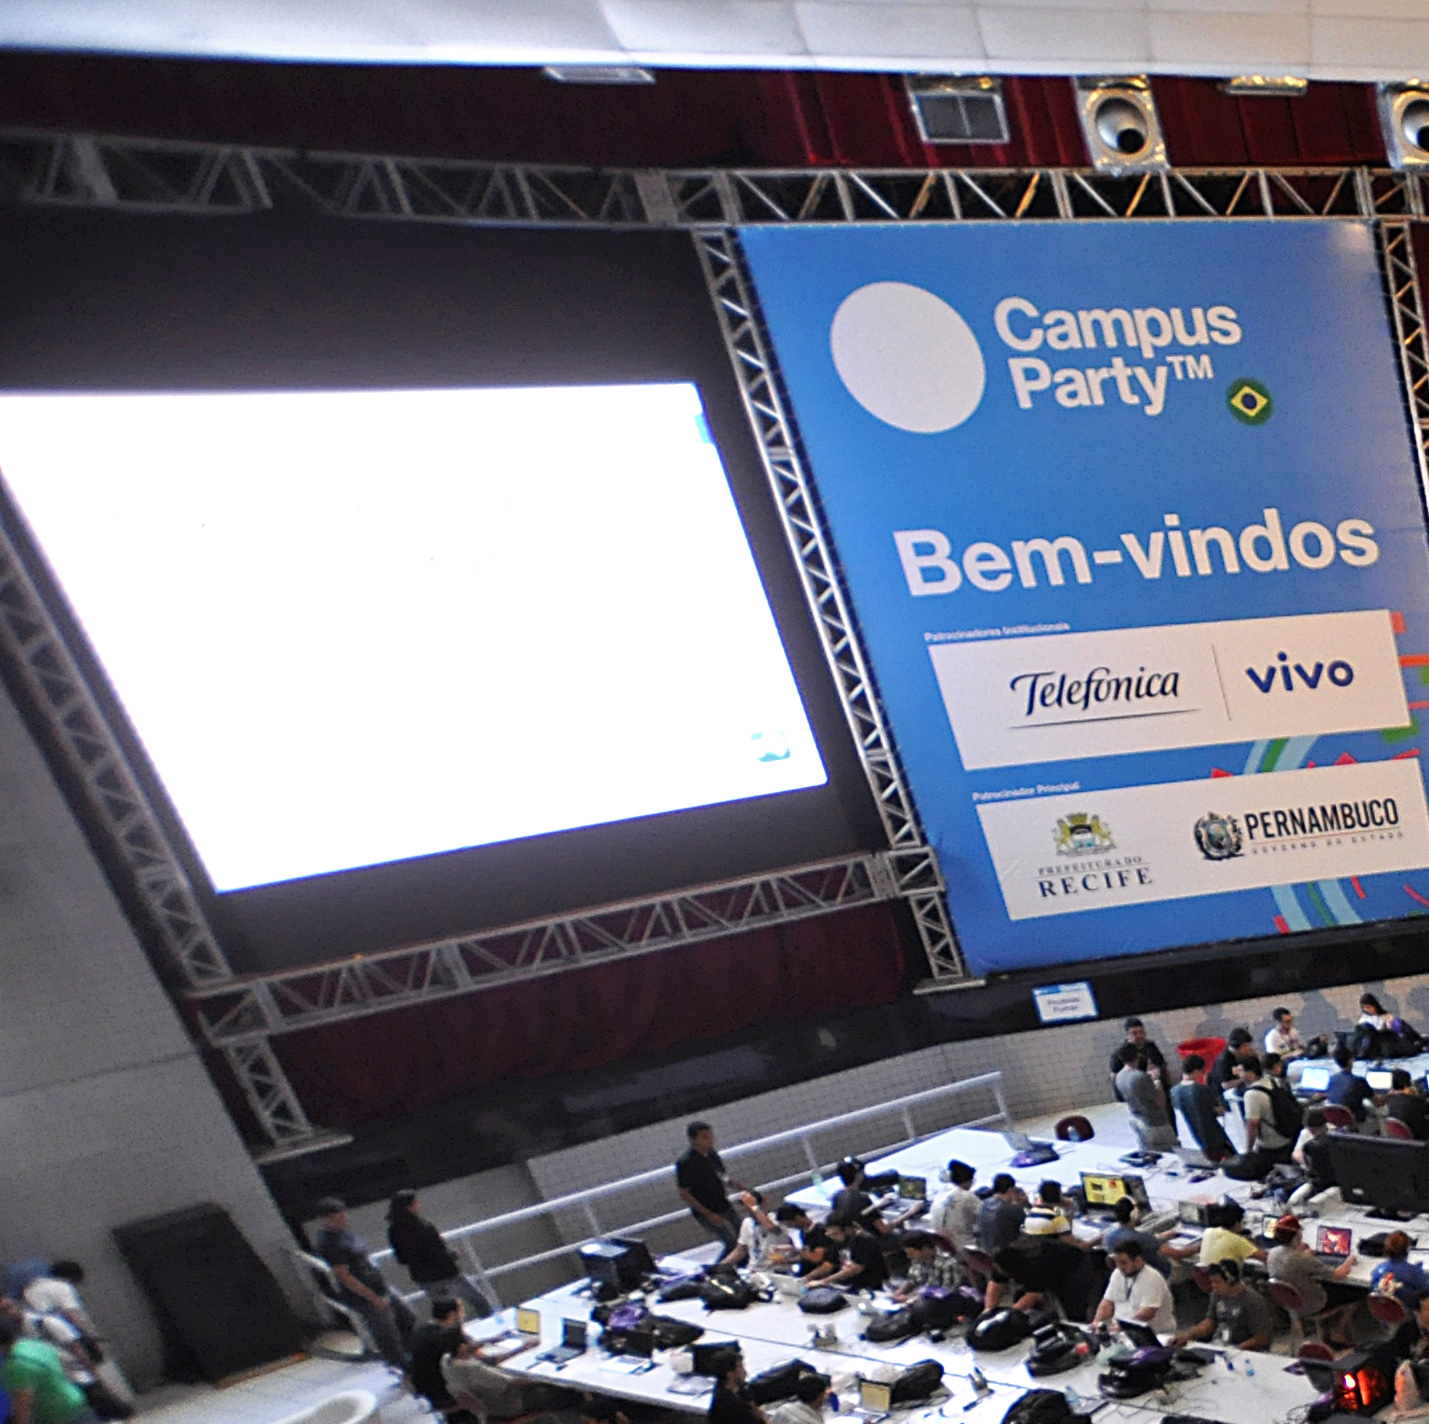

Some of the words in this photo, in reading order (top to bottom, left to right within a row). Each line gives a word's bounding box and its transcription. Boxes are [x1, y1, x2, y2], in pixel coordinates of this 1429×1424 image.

[994, 296, 1242, 359] Campus
[893, 507, 1379, 597] Bem-vindos
[1245, 651, 1354, 694] vivo
[1243, 798, 1400, 841] PERNAMBUCO
[1038, 867, 1153, 898] RECIFE
